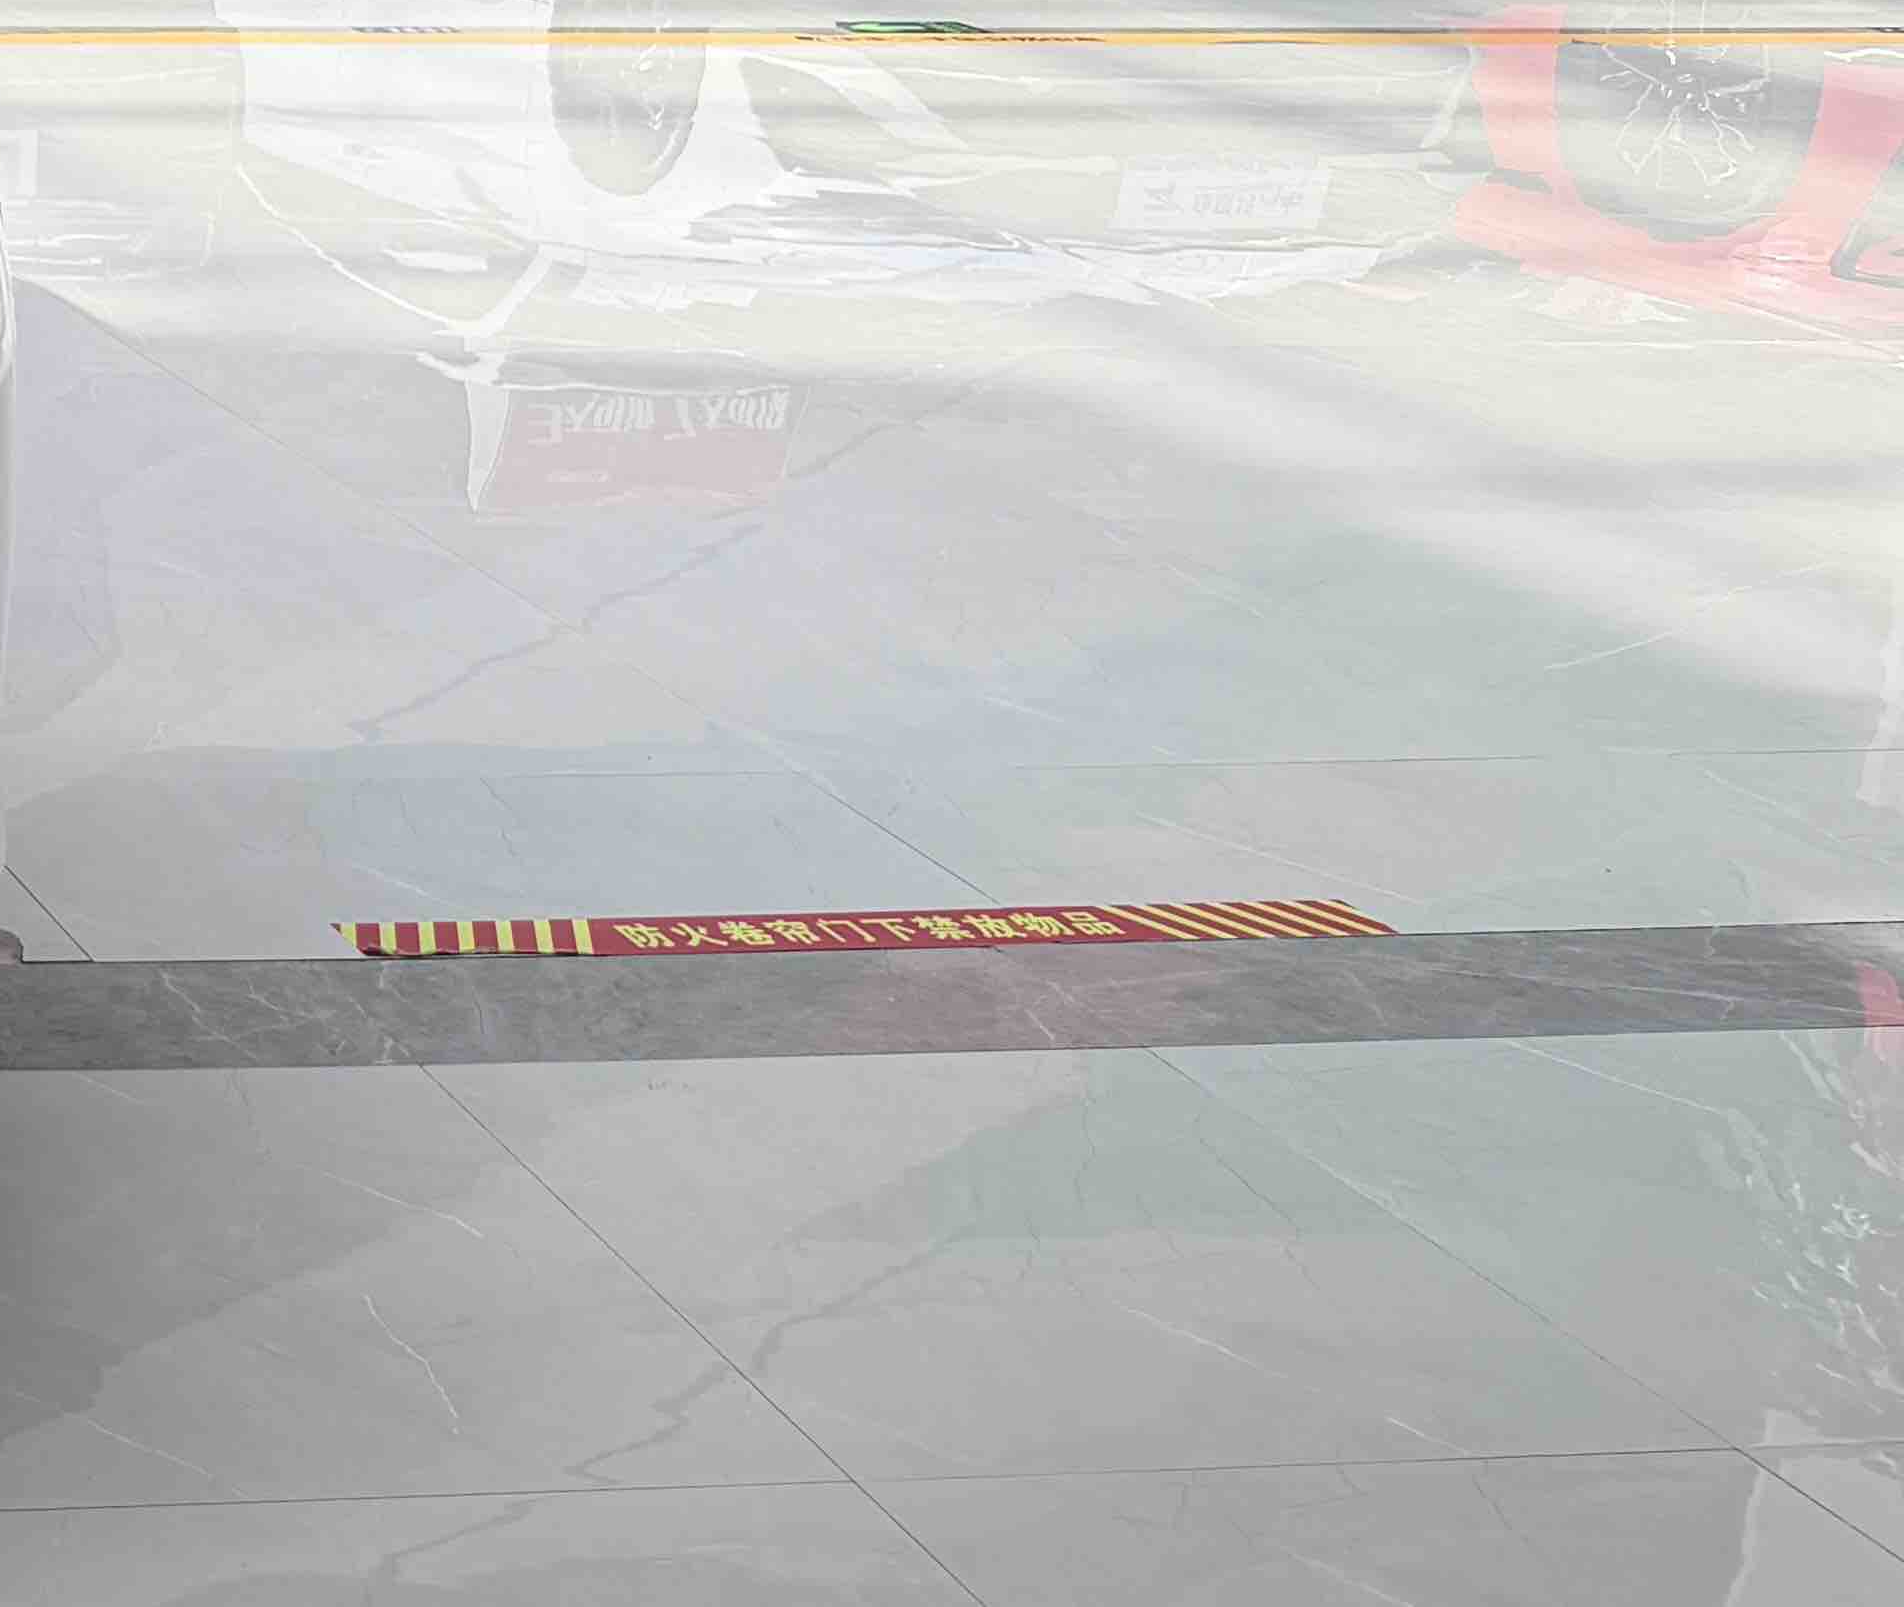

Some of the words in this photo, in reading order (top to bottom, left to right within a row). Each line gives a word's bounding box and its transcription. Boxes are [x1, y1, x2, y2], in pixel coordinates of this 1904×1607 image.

[614, 910, 1126, 950] 防火卷帘门下禁放物品
